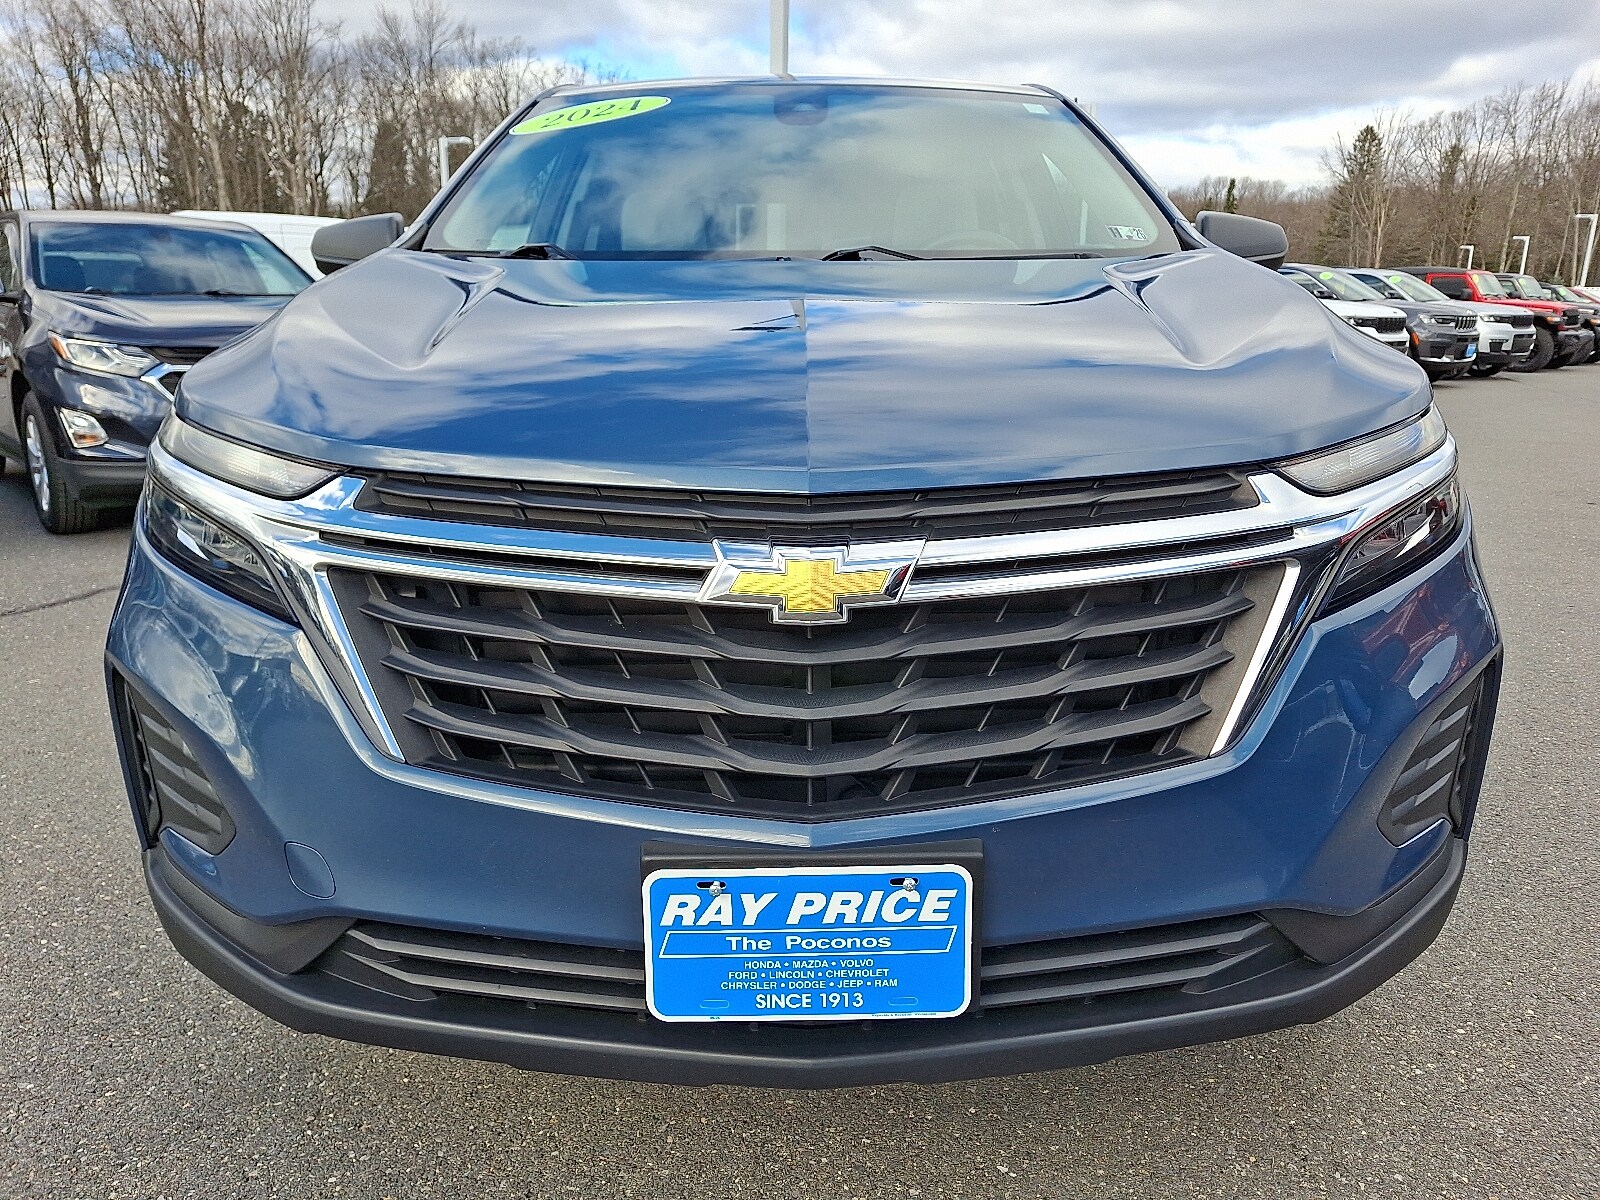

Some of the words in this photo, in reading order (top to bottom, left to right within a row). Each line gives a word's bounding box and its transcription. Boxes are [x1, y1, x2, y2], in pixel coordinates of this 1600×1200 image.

[541, 98, 641, 128] 2024
[659, 892, 778, 927] RAY
[786, 889, 959, 925] PRICE
[725, 935, 772, 951] The
[786, 935, 892, 951] Poconos
[744, 960, 781, 970] HONDA
[792, 959, 829, 969] MAZDA
[840, 958, 874, 968] VOLVO
[728, 971, 757, 979] FORD
[769, 970, 815, 979] LINCOLN
[825, 968, 890, 978] CHEVROLET
[720, 981, 777, 990] CHRYSLER
[788, 980, 826, 989] DODGE
[837, 979, 864, 988] JEEP
[874, 978, 898, 987] RAM
[755, 993, 812, 1009] SINCE
[819, 992, 864, 1008] 1913
